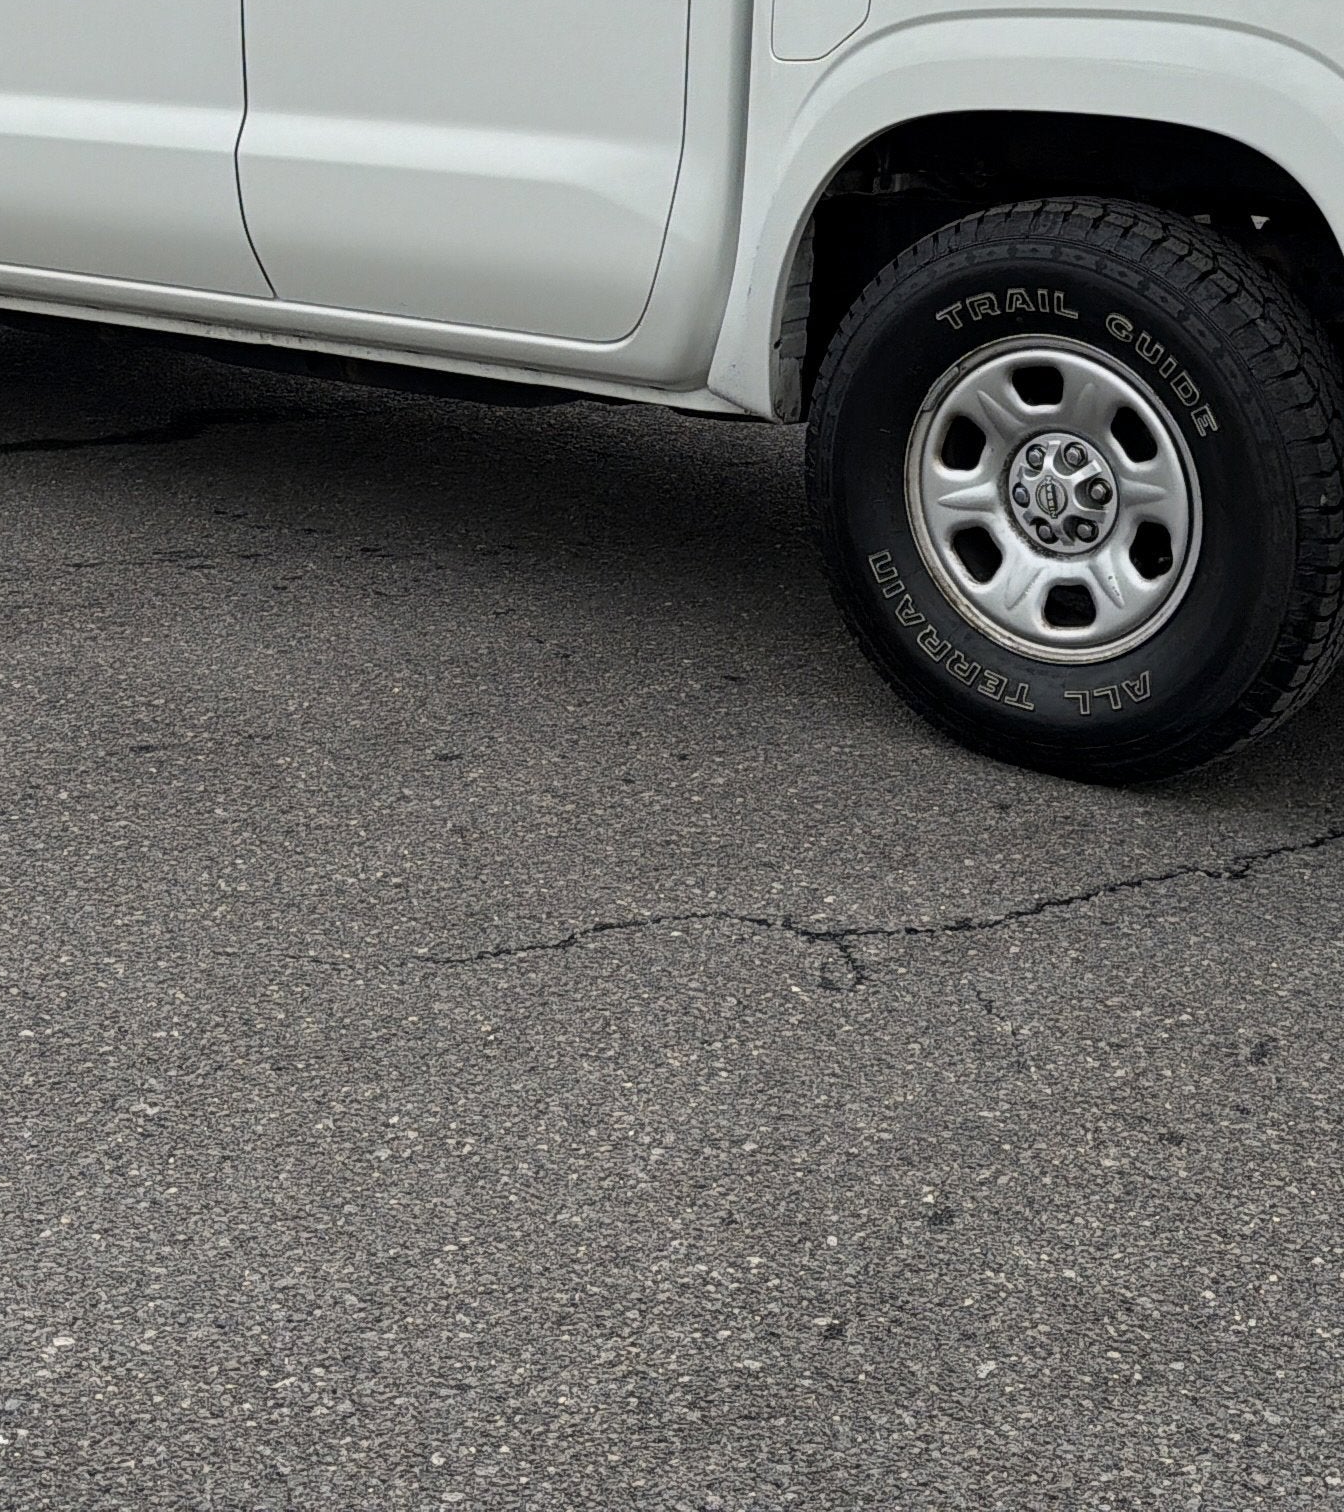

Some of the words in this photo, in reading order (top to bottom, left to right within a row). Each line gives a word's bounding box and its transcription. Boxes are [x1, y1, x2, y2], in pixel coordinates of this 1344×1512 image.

[935, 287, 1079, 331] TRAIL
[1105, 311, 1219, 438] GUIDE
[868, 548, 1036, 710] TERRAIN
[1064, 670, 1152, 716] ALL
